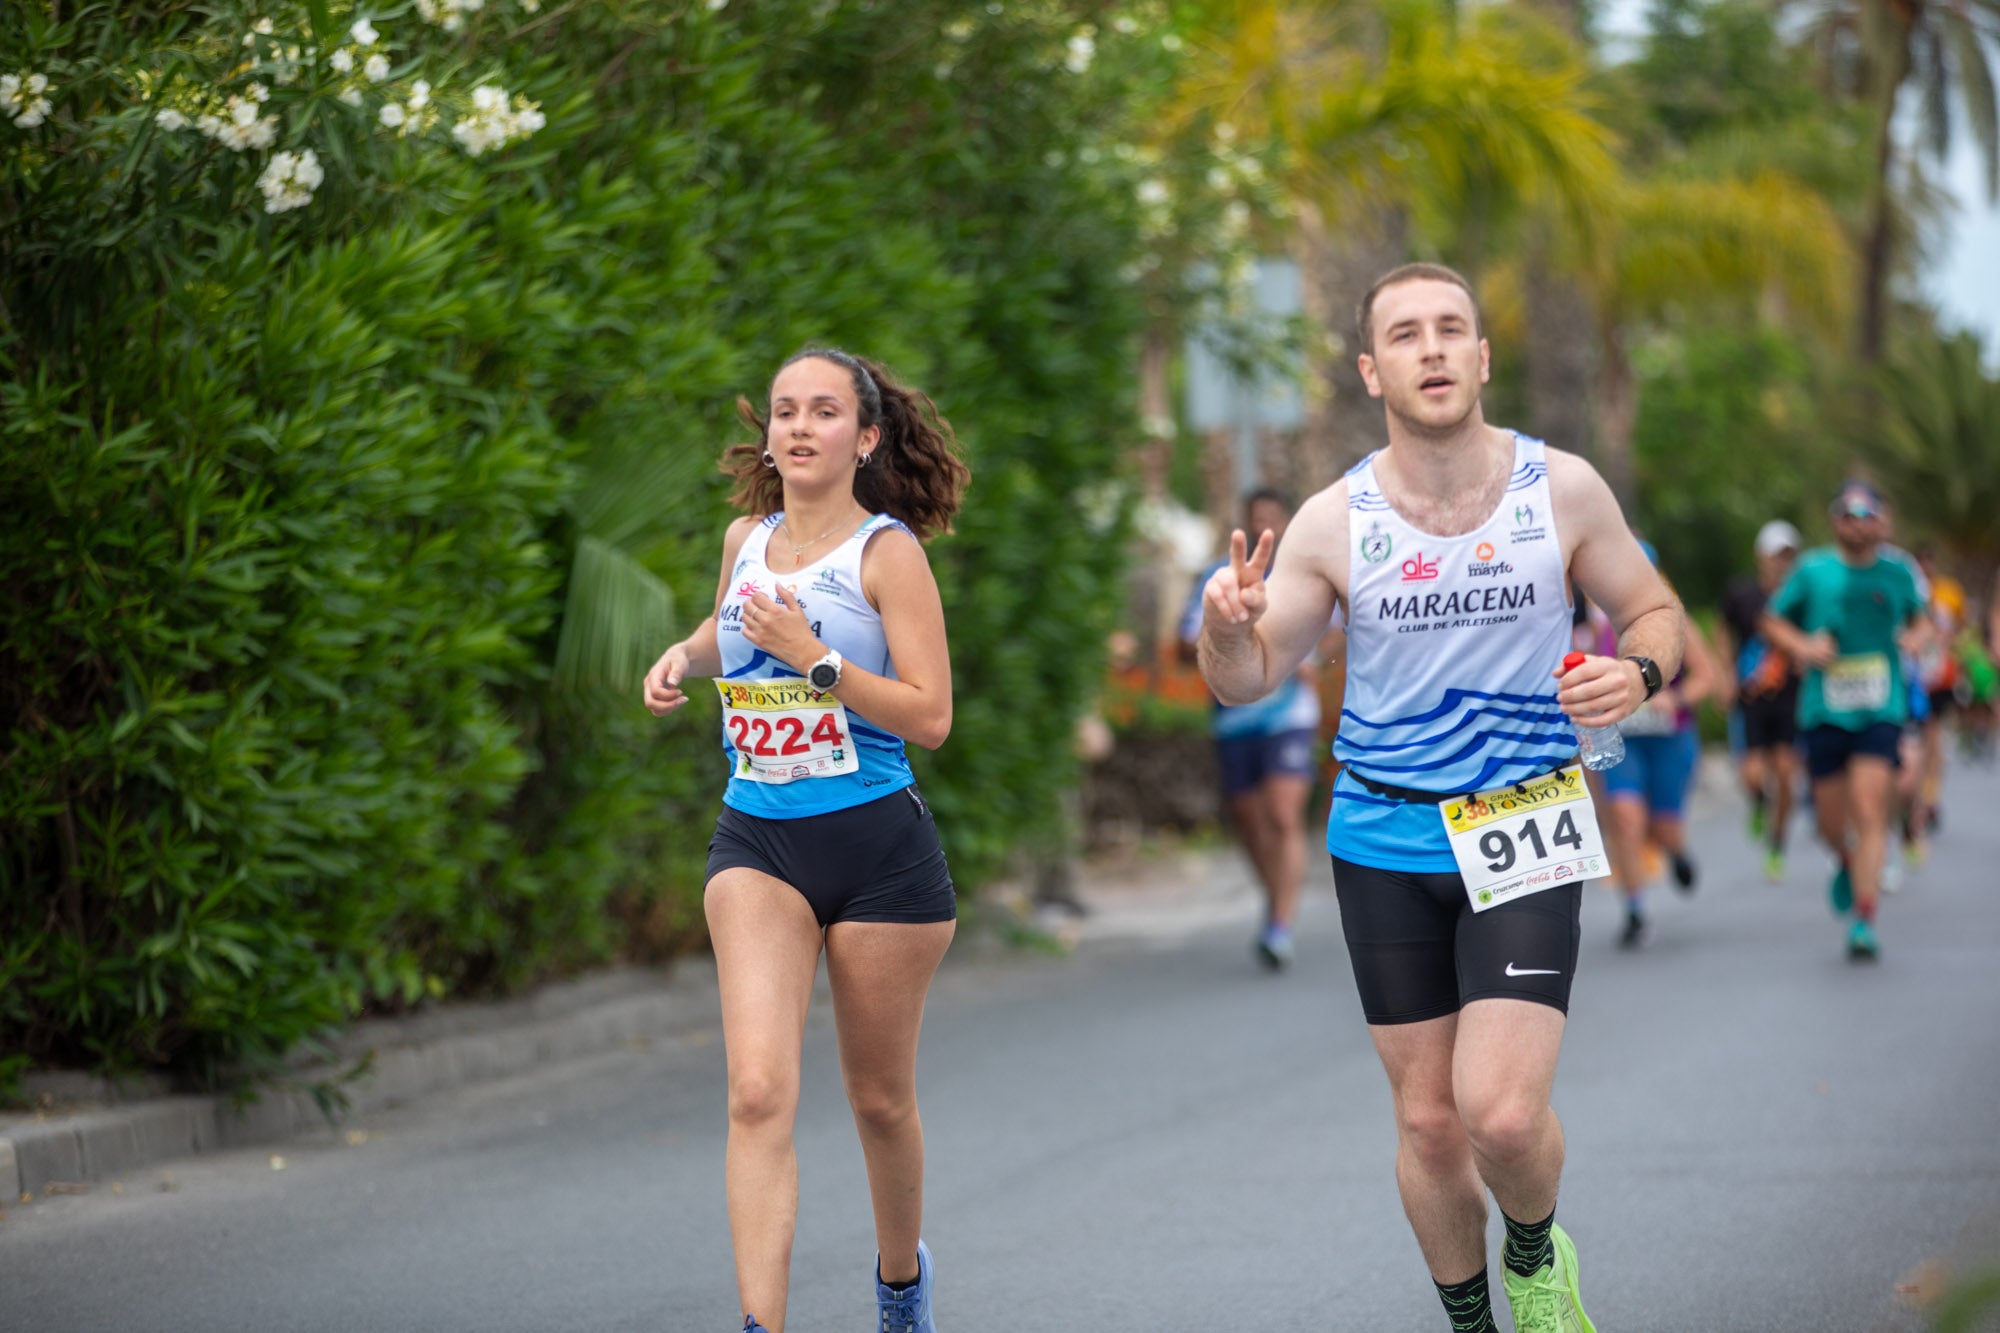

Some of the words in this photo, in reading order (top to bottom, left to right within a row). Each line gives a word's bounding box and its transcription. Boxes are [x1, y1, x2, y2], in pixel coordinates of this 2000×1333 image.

[1468, 561, 1514, 577] mayfo
[1378, 582, 1536, 621] MARACENA
[1397, 622, 1429, 634] CLUB
[1433, 620, 1449, 630] DE
[1452, 614, 1519, 628] ATLETISMO
[731, 685, 749, 702] 38
[748, 690, 810, 705] FONDO
[768, 684, 802, 692] PREMIO
[729, 713, 845, 756] 2224
[1464, 799, 1490, 821] 38
[1489, 786, 1559, 814] FONDO
[1479, 809, 1583, 873] 914
[1492, 879, 1524, 895] Cruzcampo
